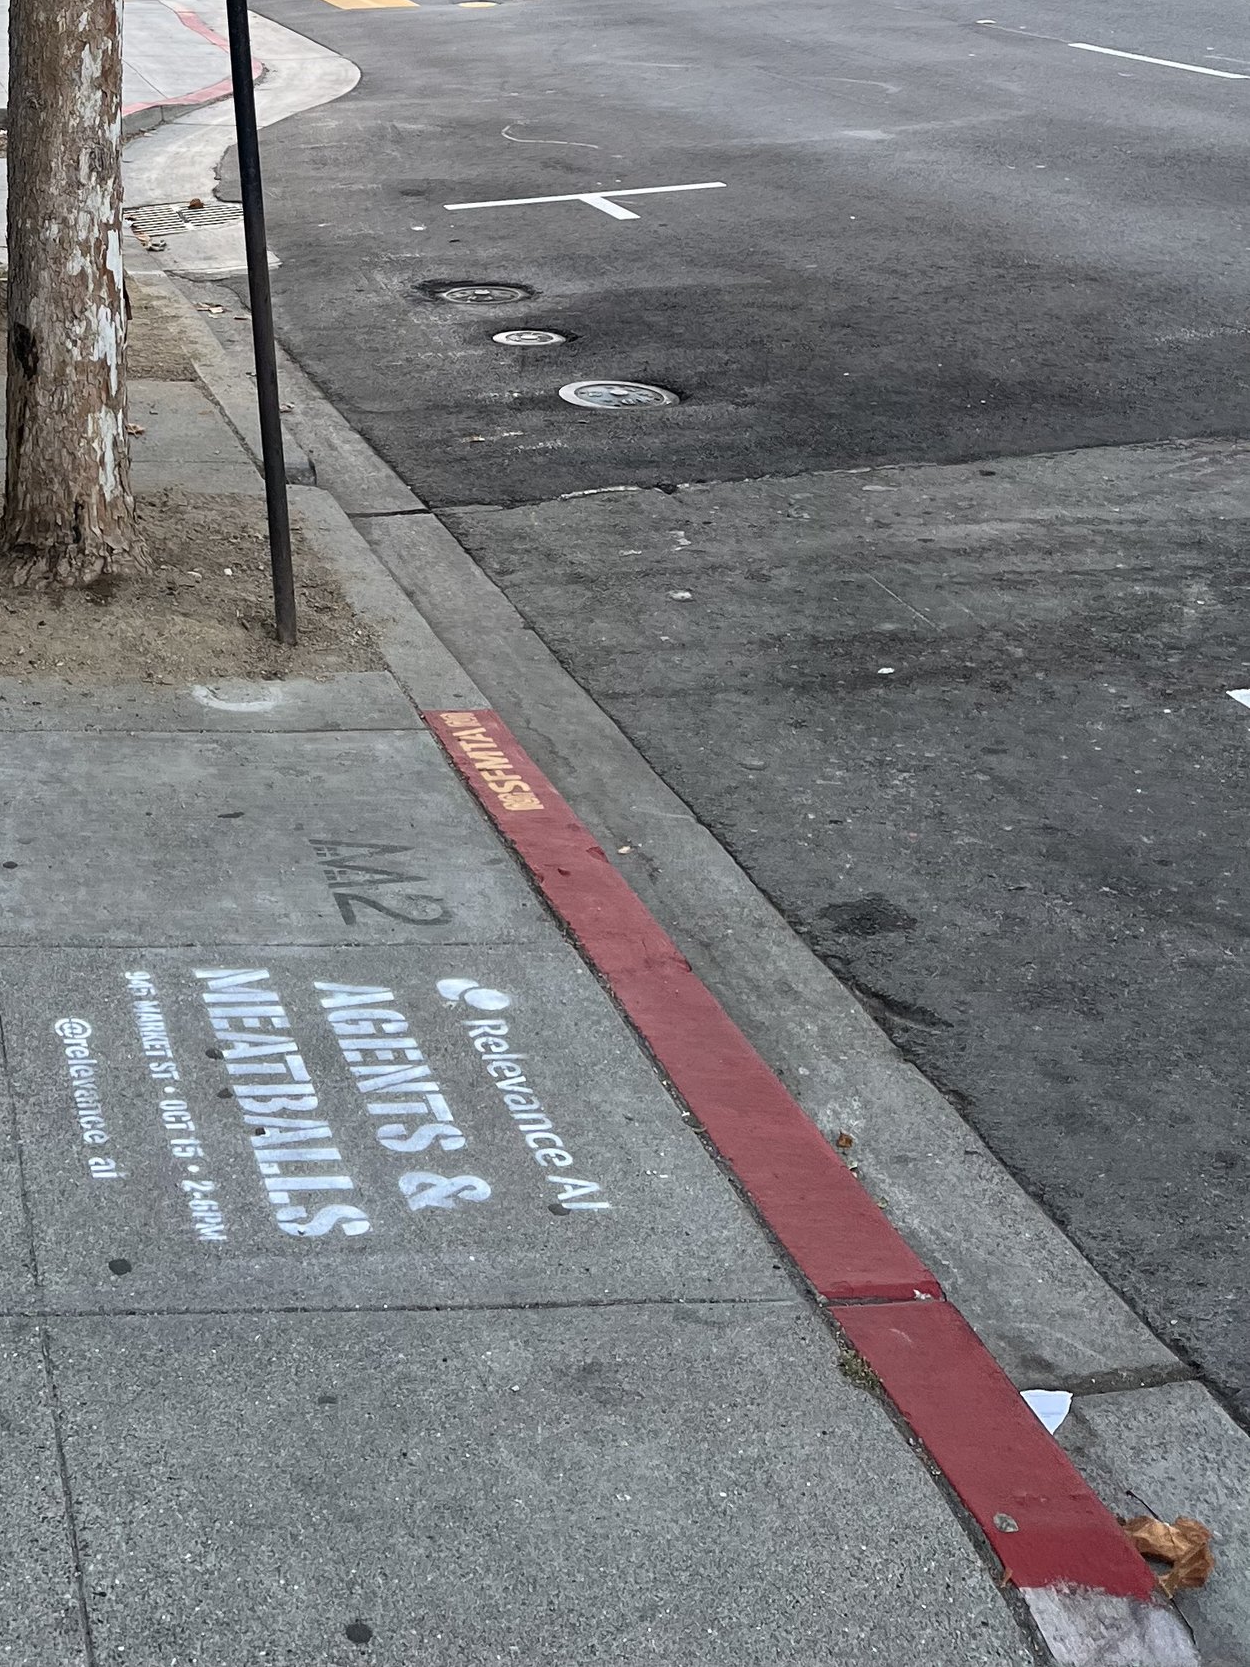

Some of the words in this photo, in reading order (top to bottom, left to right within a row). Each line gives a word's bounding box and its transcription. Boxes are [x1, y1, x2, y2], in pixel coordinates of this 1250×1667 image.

[452, 726, 532, 796] SFMTA
[124, 970, 155, 997] 945
[132, 998, 177, 1058] MARKET
[147, 1060, 180, 1081] ST
[313, 980, 466, 1153] AGENTS
[397, 1171, 492, 1212] &
[158, 1097, 195, 1132] OCT
[194, 967, 371, 1237] MEATBALLS
[461, 1017, 575, 1169] Relevance
[547, 1172, 611, 1213] AI
[169, 1136, 204, 1159] 15
[179, 1178, 228, 1242] 2-6PM
